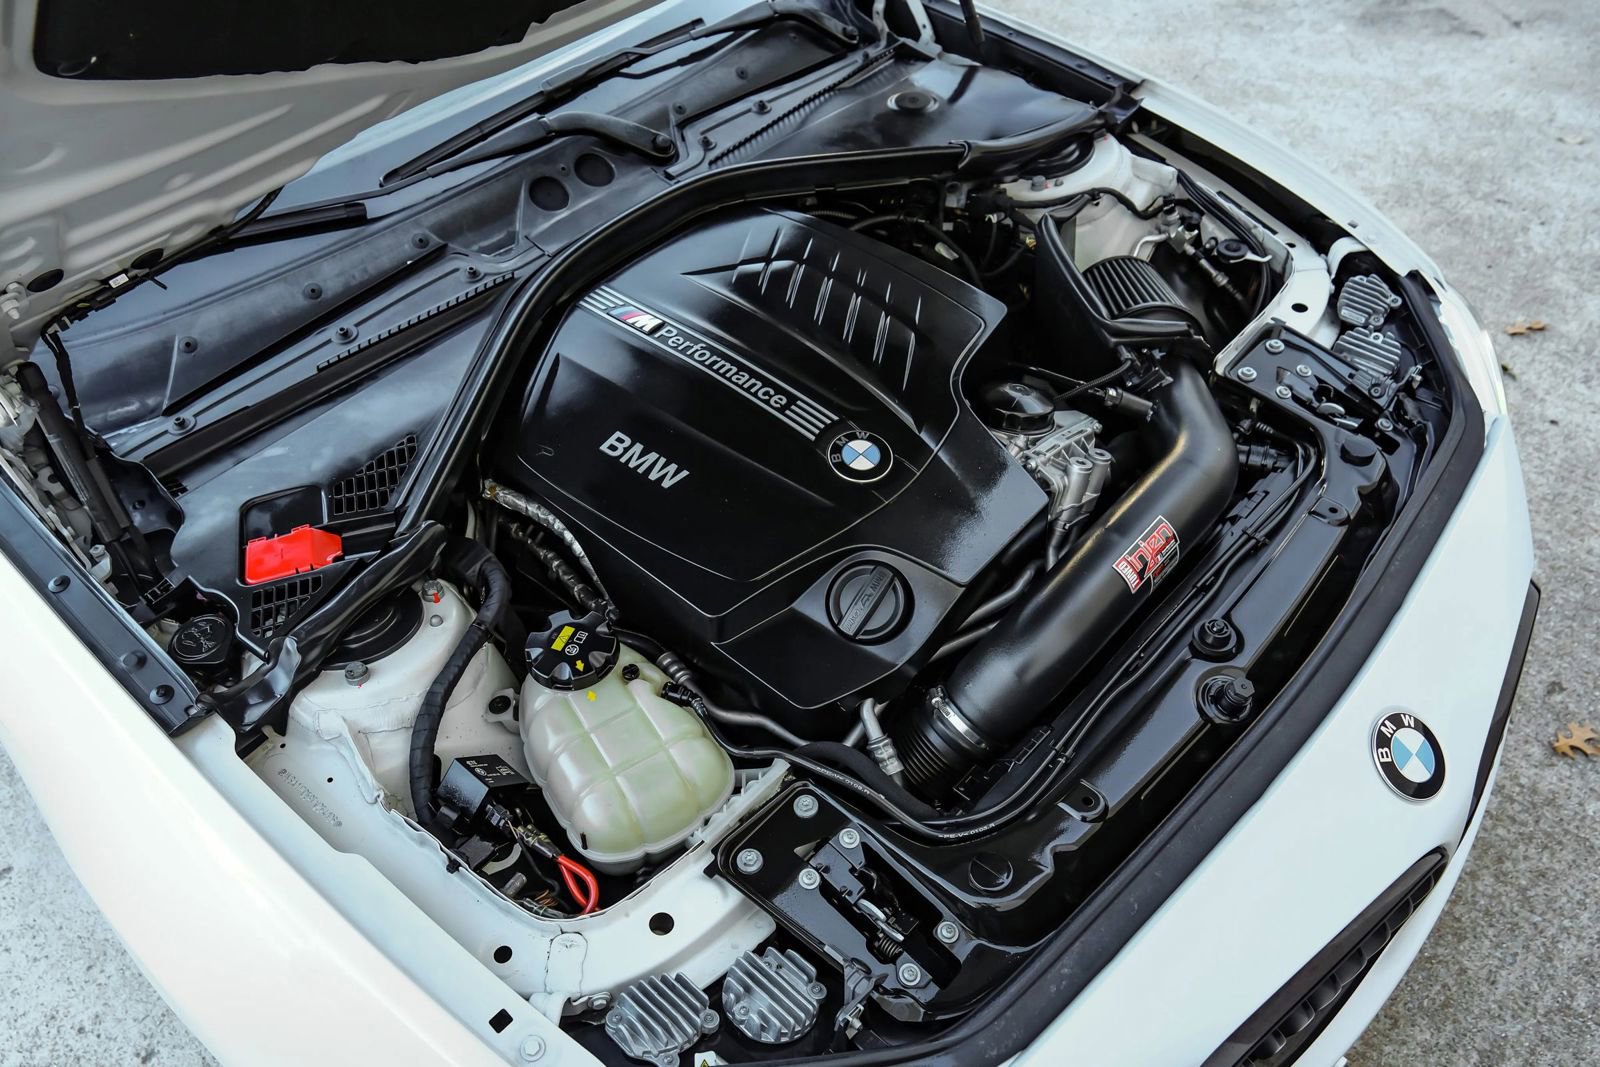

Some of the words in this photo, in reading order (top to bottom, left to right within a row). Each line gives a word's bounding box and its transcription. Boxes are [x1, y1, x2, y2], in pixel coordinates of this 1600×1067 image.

[653, 325, 789, 410] Performance
[599, 430, 690, 490] BMW
[831, 431, 870, 463] BMW
[1118, 560, 1140, 589] TUNED
[1124, 522, 1174, 578] injen
[1377, 713, 1416, 763] BMW
